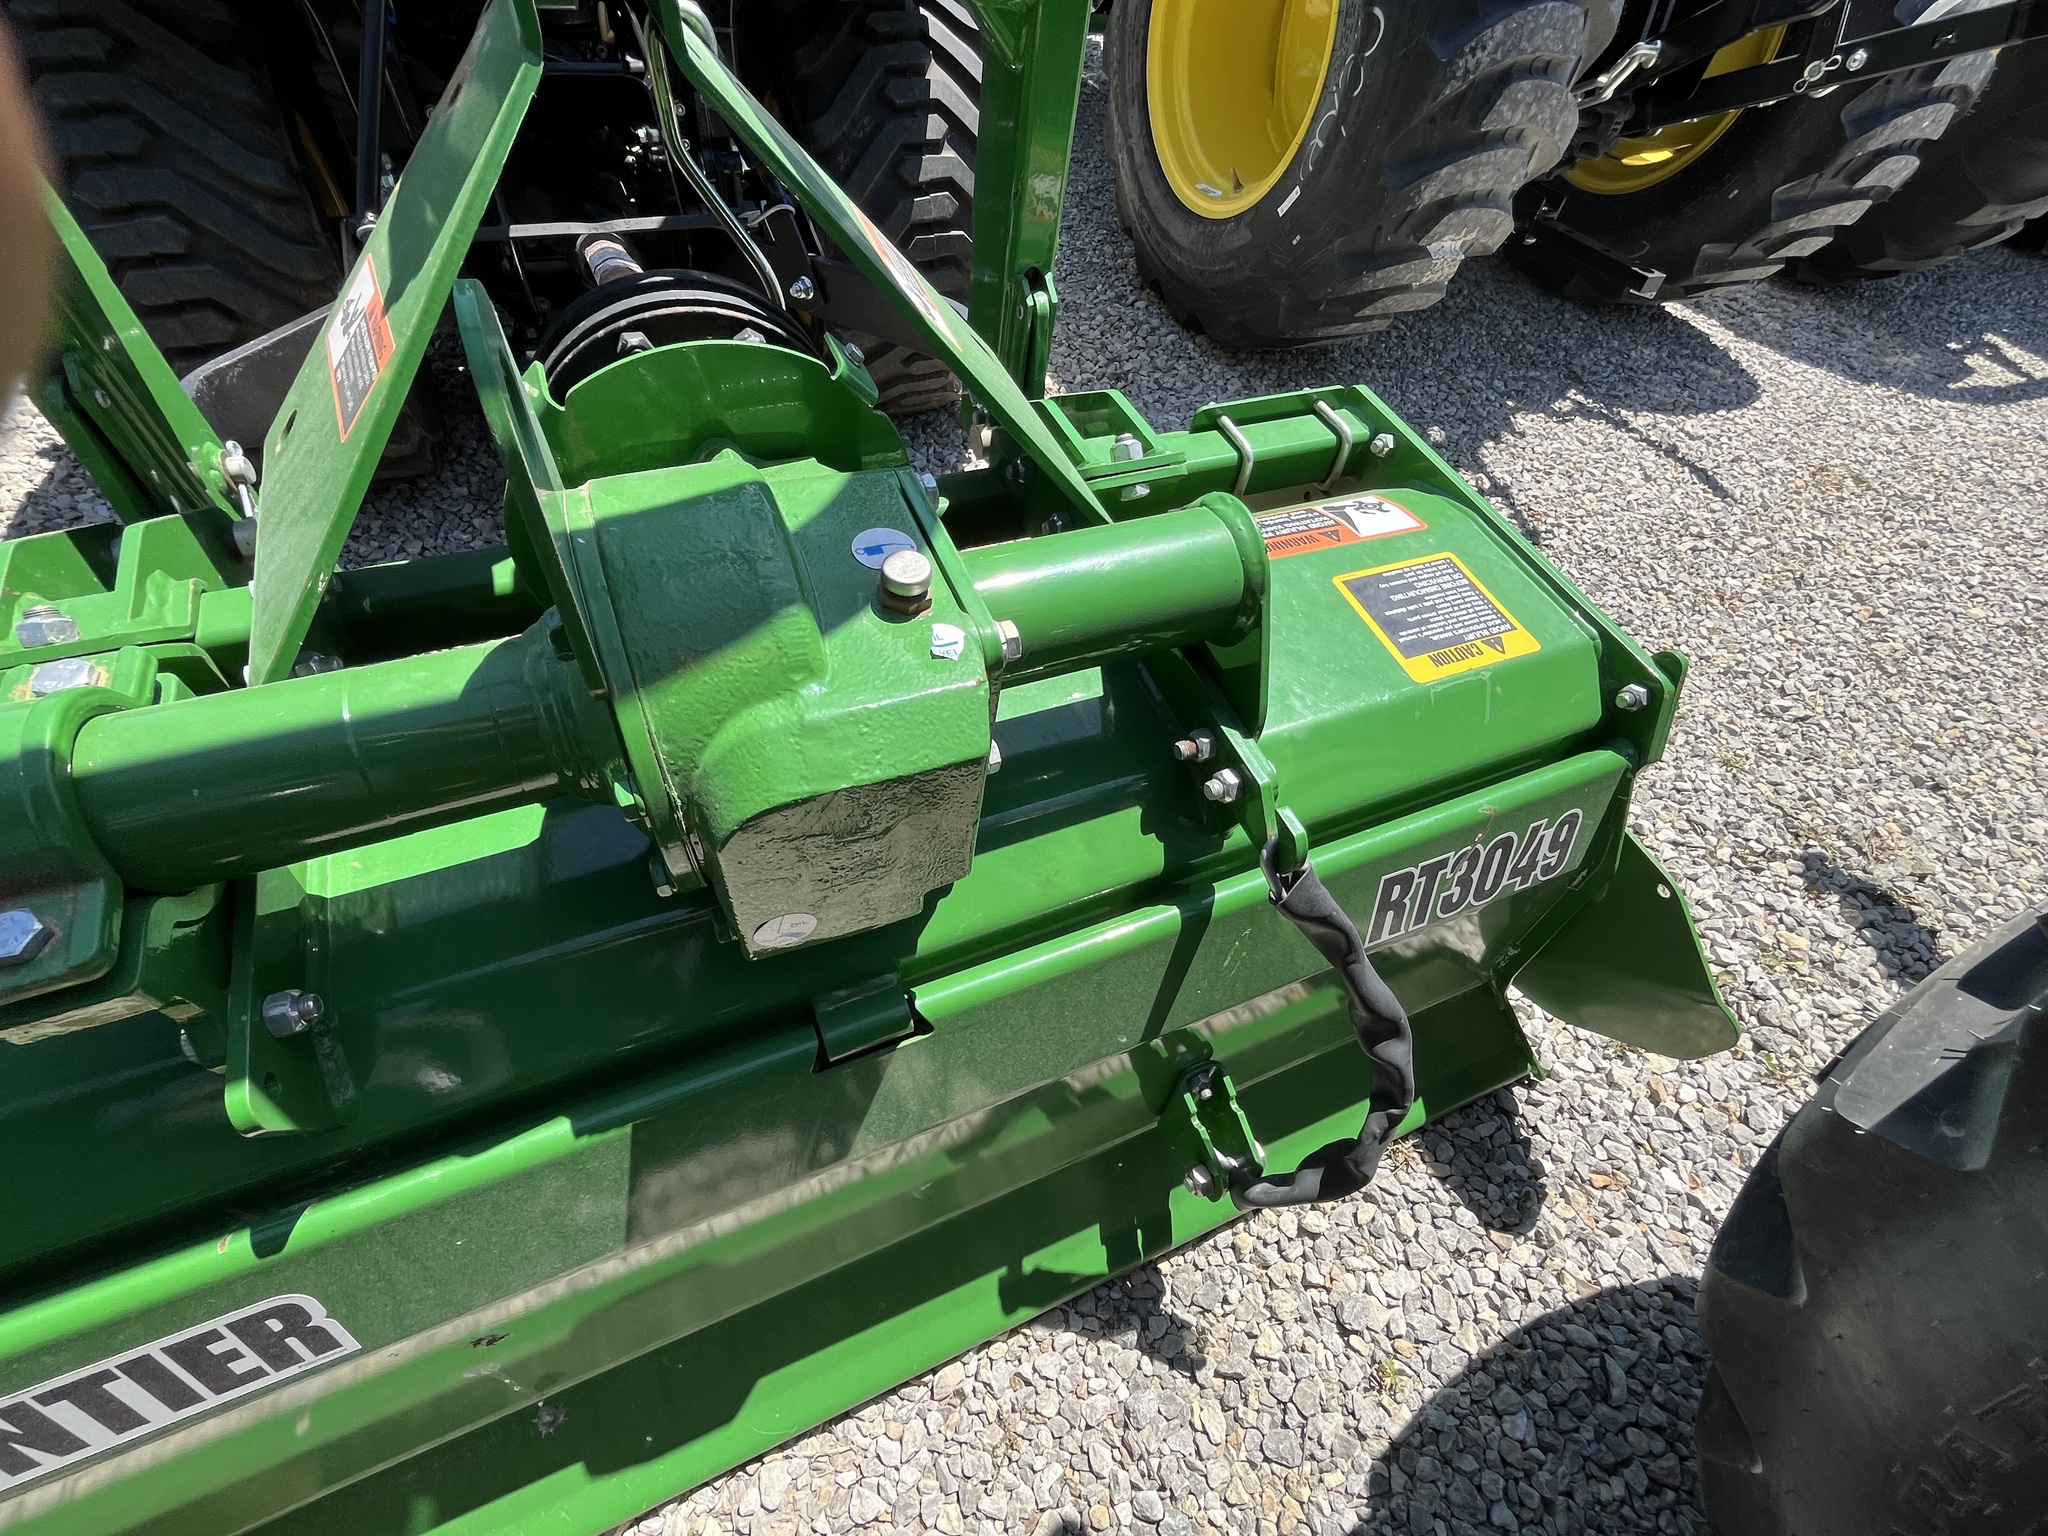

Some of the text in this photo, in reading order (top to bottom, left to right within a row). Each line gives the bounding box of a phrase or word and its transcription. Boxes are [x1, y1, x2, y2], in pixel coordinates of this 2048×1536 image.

[1390, 578, 1469, 601] BEFORE DISMOUNTING
[1413, 575, 1452, 588] SERVICING
[1463, 623, 1511, 641] AVOID INJURY
[1427, 642, 1484, 667] CAUTION
[1365, 809, 1583, 948] RT3049
[790, 920, 809, 928] OIL
[0, 1303, 343, 1477] NTIER
